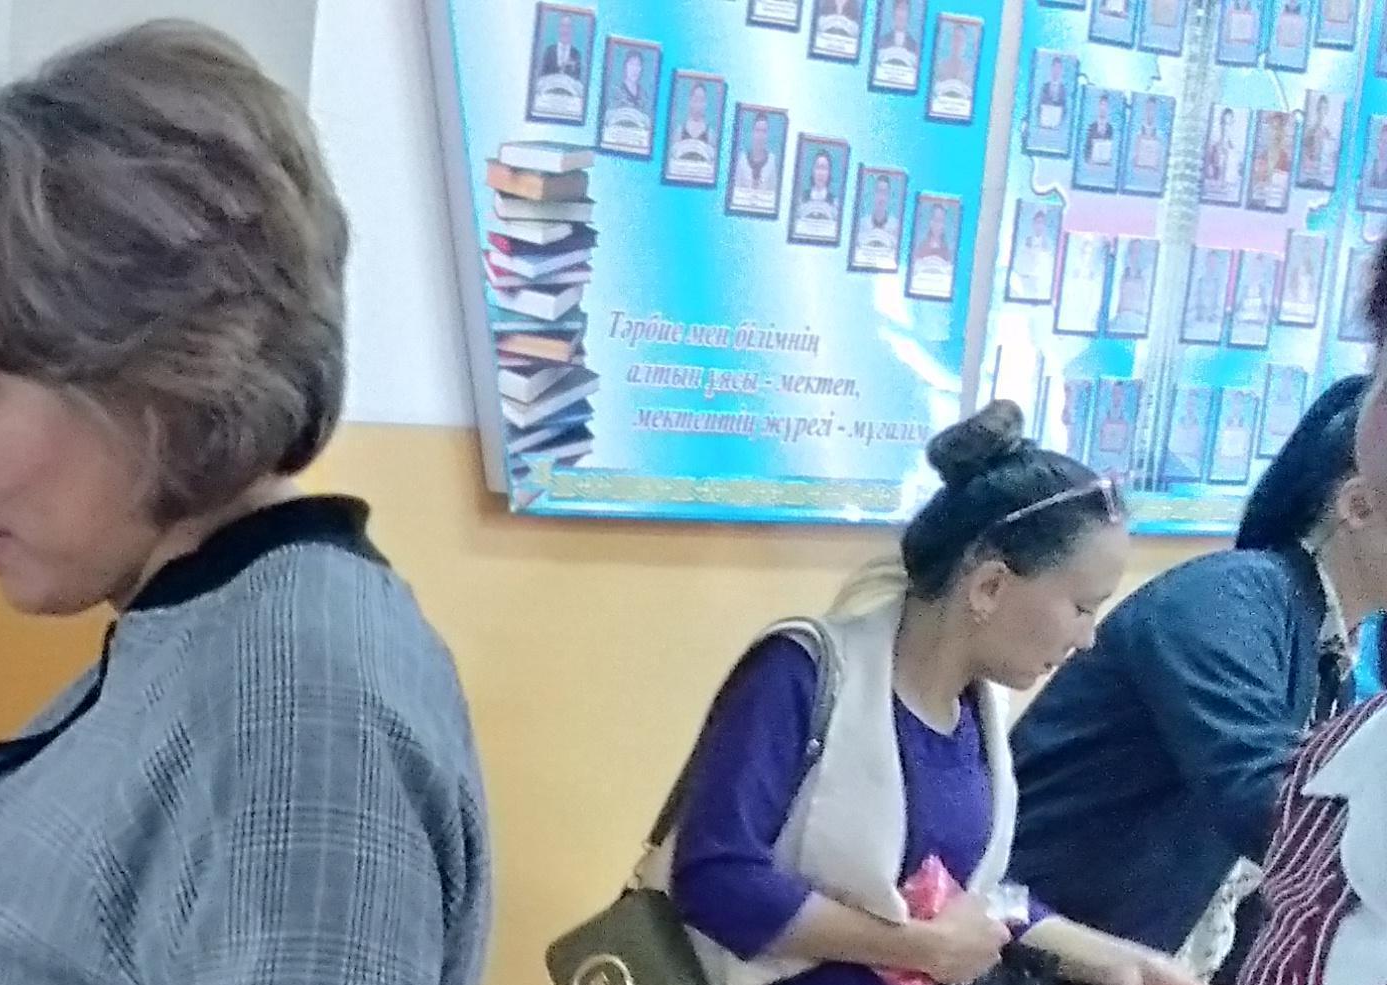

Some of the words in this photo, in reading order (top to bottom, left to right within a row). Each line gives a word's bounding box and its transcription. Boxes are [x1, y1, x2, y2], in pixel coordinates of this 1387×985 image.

[686, 322, 729, 346] мен
[627, 364, 702, 388] алтын
[776, 374, 861, 400] мектеп,
